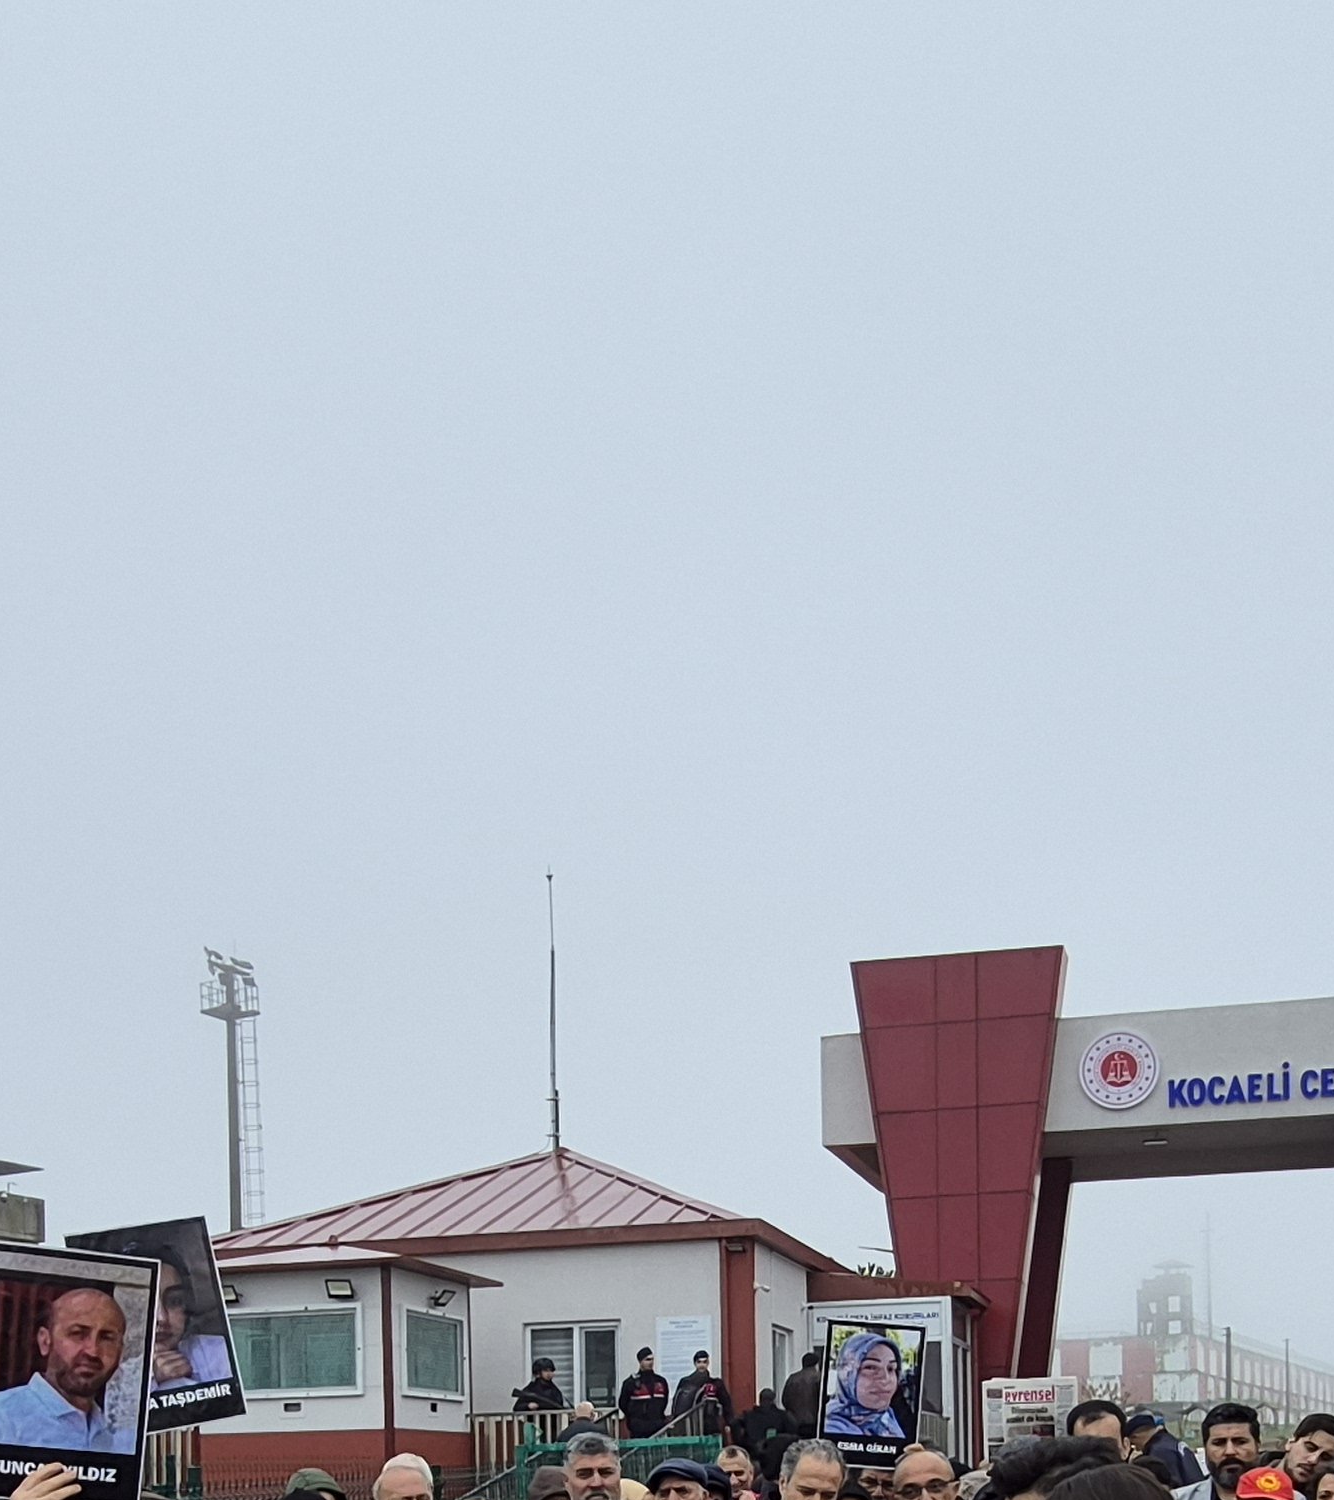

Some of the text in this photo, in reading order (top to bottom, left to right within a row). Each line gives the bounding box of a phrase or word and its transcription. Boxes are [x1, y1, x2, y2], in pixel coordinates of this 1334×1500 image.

[1168, 1061, 1291, 1109] KOCAELİ
[159, 1382, 232, 1408] TAŞDEMİR
[1004, 1384, 1056, 1403] evrensel
